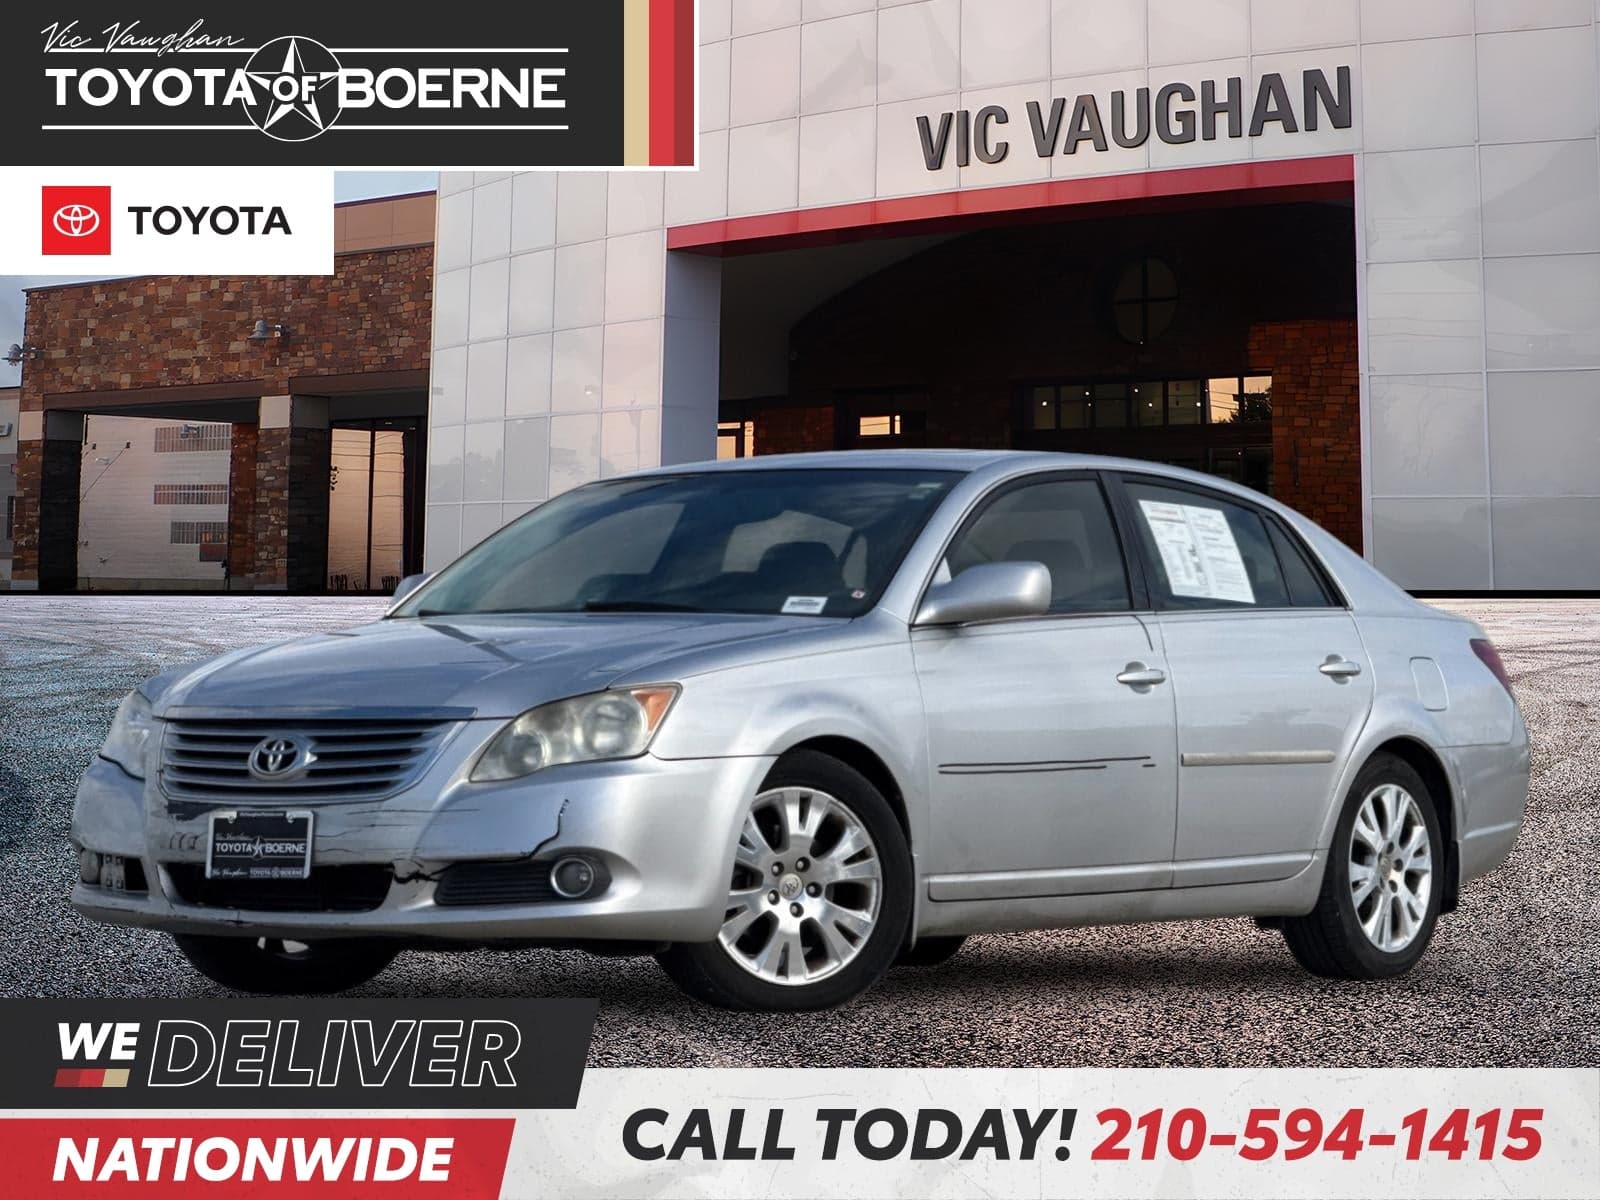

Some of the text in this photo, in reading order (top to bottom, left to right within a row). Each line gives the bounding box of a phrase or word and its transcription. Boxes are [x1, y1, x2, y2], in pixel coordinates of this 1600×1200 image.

[915, 65, 1353, 171] VIC VAUGHAN
[215, 842, 305, 854] TOYOTA BOERNE
